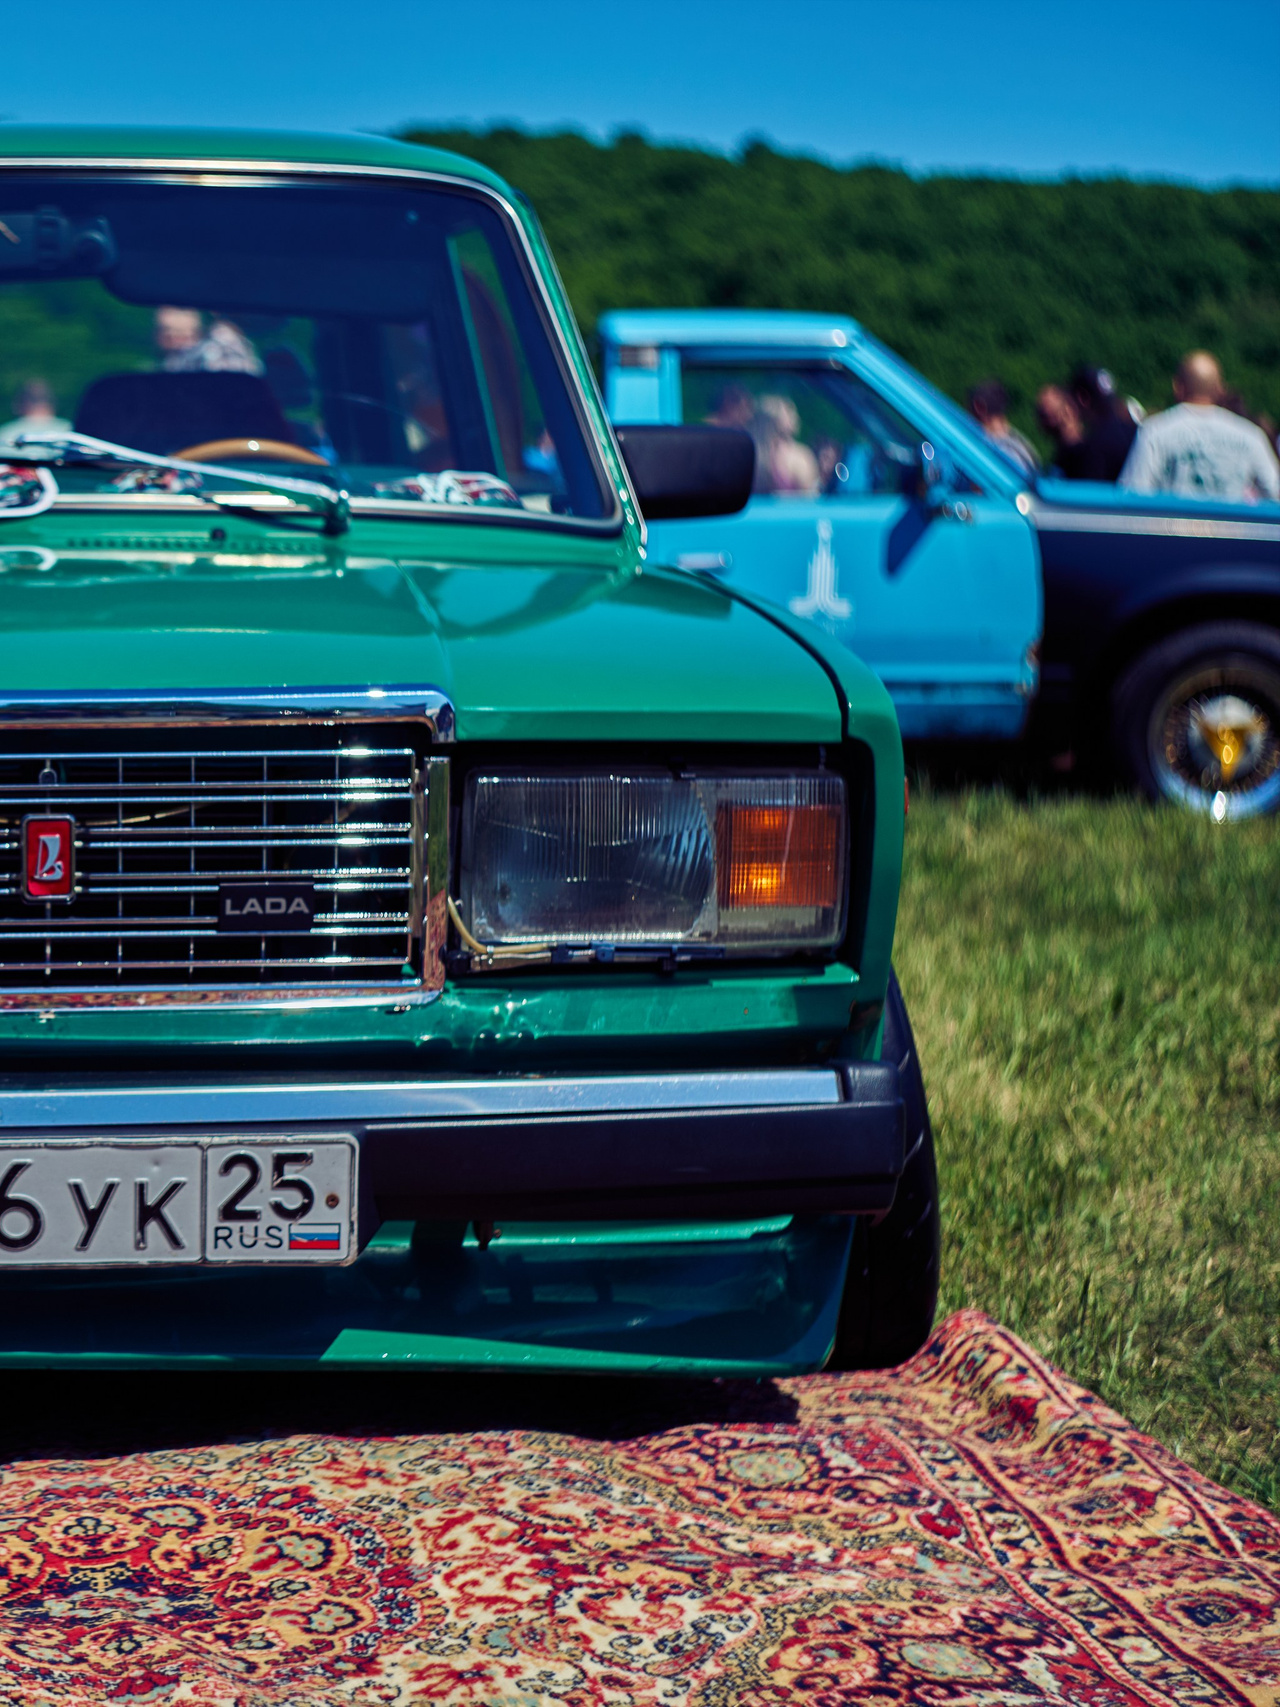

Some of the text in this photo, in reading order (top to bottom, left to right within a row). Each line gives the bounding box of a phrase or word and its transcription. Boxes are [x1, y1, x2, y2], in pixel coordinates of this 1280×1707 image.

[225, 897, 310, 916] LADA
[218, 1149, 315, 1223] 25
[213, 1225, 284, 1250] RUS
